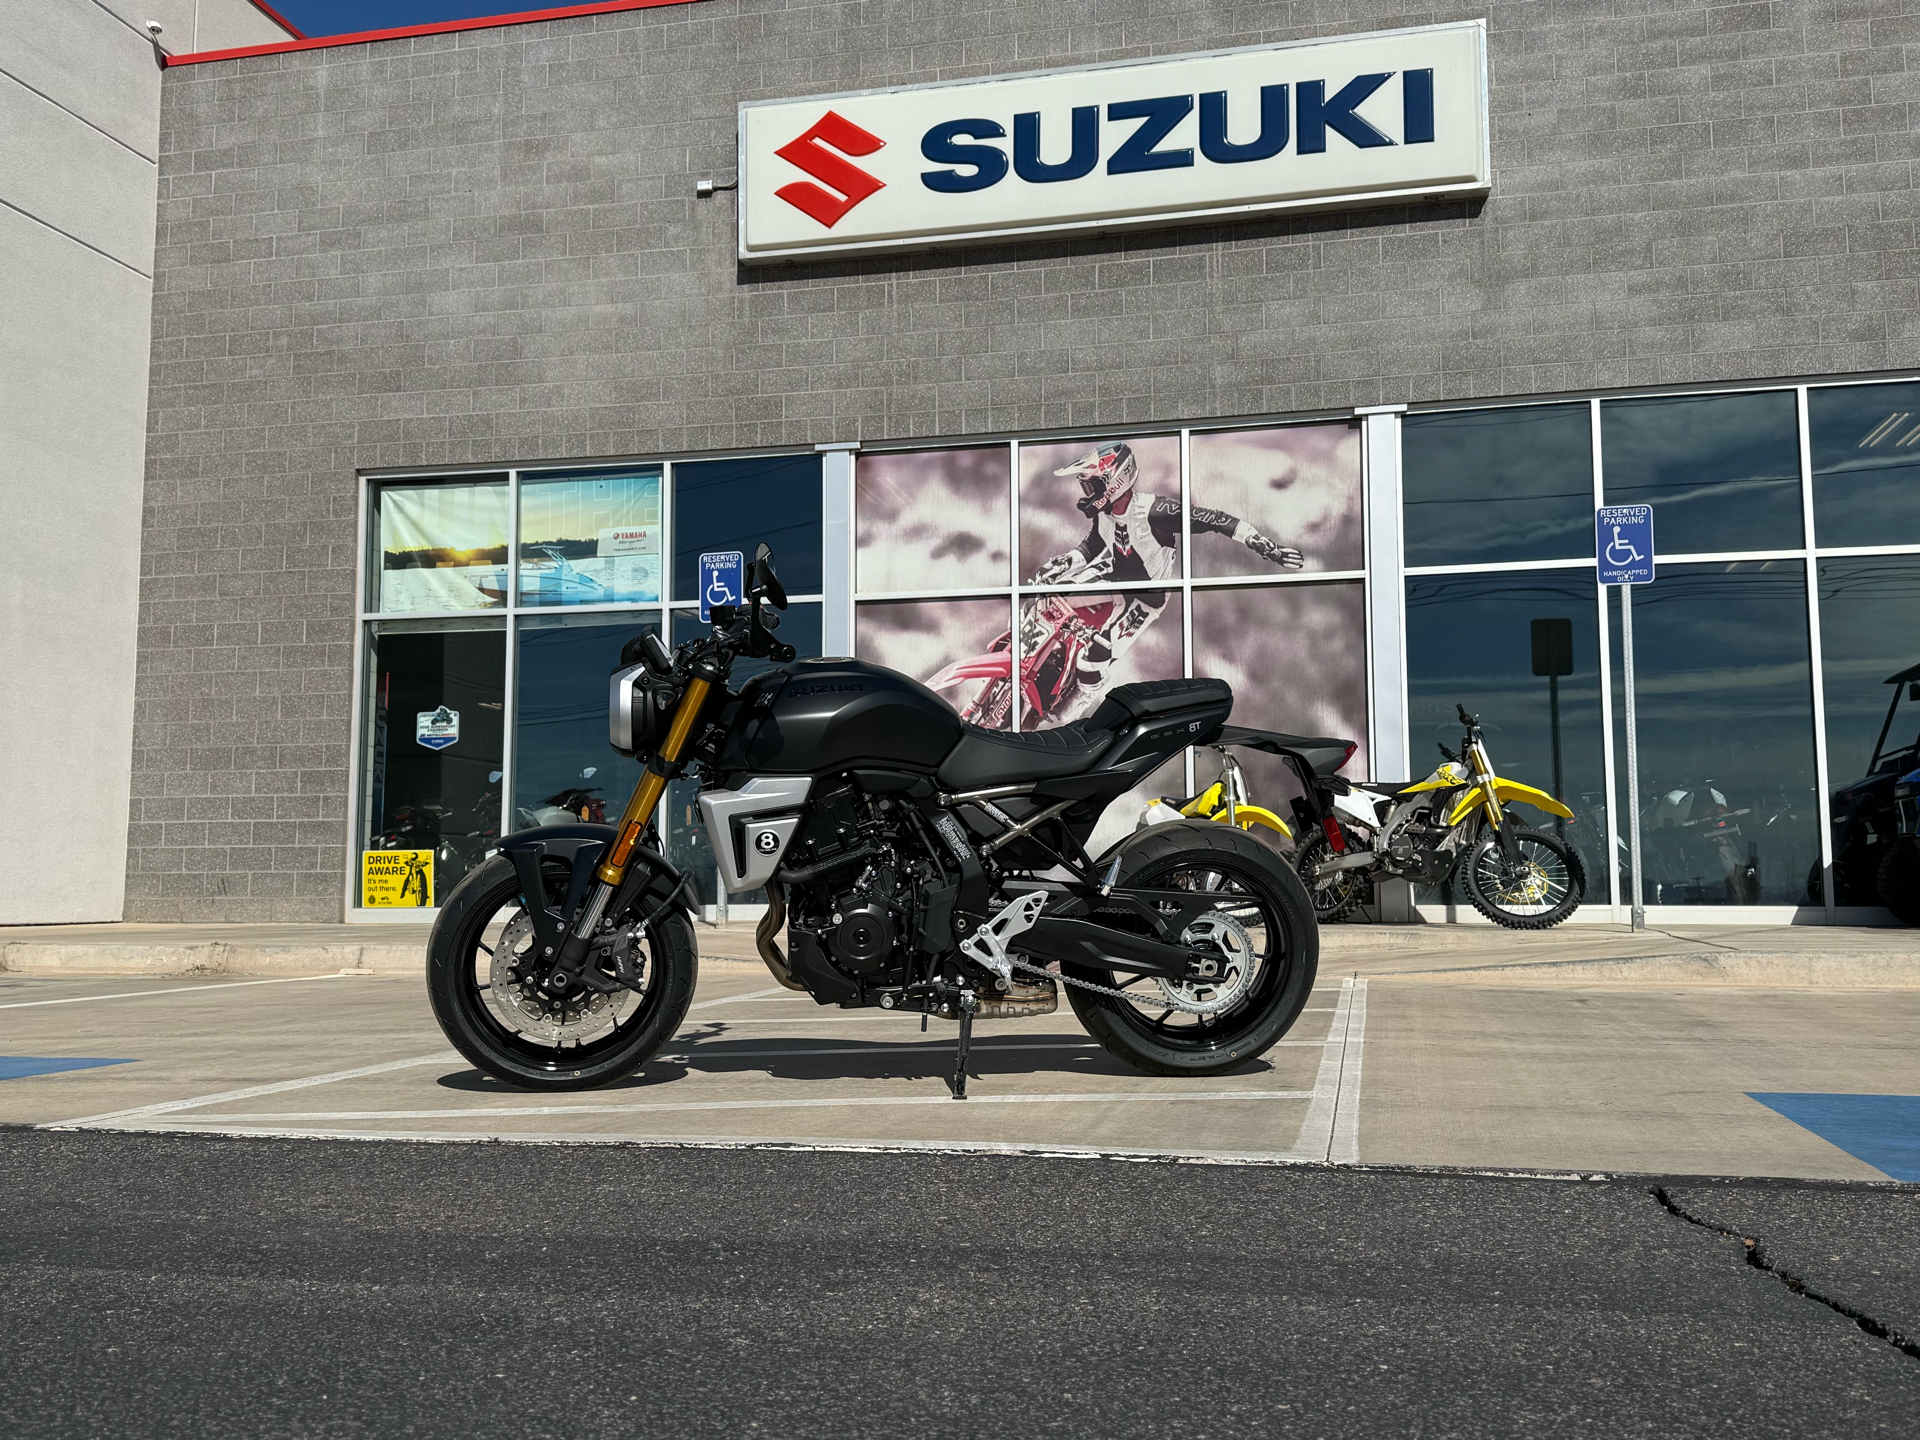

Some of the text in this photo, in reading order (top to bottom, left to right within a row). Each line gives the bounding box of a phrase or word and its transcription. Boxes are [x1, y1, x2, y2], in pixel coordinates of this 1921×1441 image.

[920, 68, 1434, 193] SUZUKI
[1108, 478, 1125, 494] Bull
[1600, 507, 1647, 517] RESERVED
[1604, 516, 1645, 525] PARKING
[620, 531, 646, 539] YAMAHA
[703, 554, 739, 563] RESERVED
[705, 561, 737, 570] PARKING
[788, 684, 864, 697] SUZUKI
[1188, 721, 1202, 732] 8T
[761, 833, 774, 848] 8
[368, 856, 400, 864] DRIVE
[367, 866, 406, 875] AWARE
